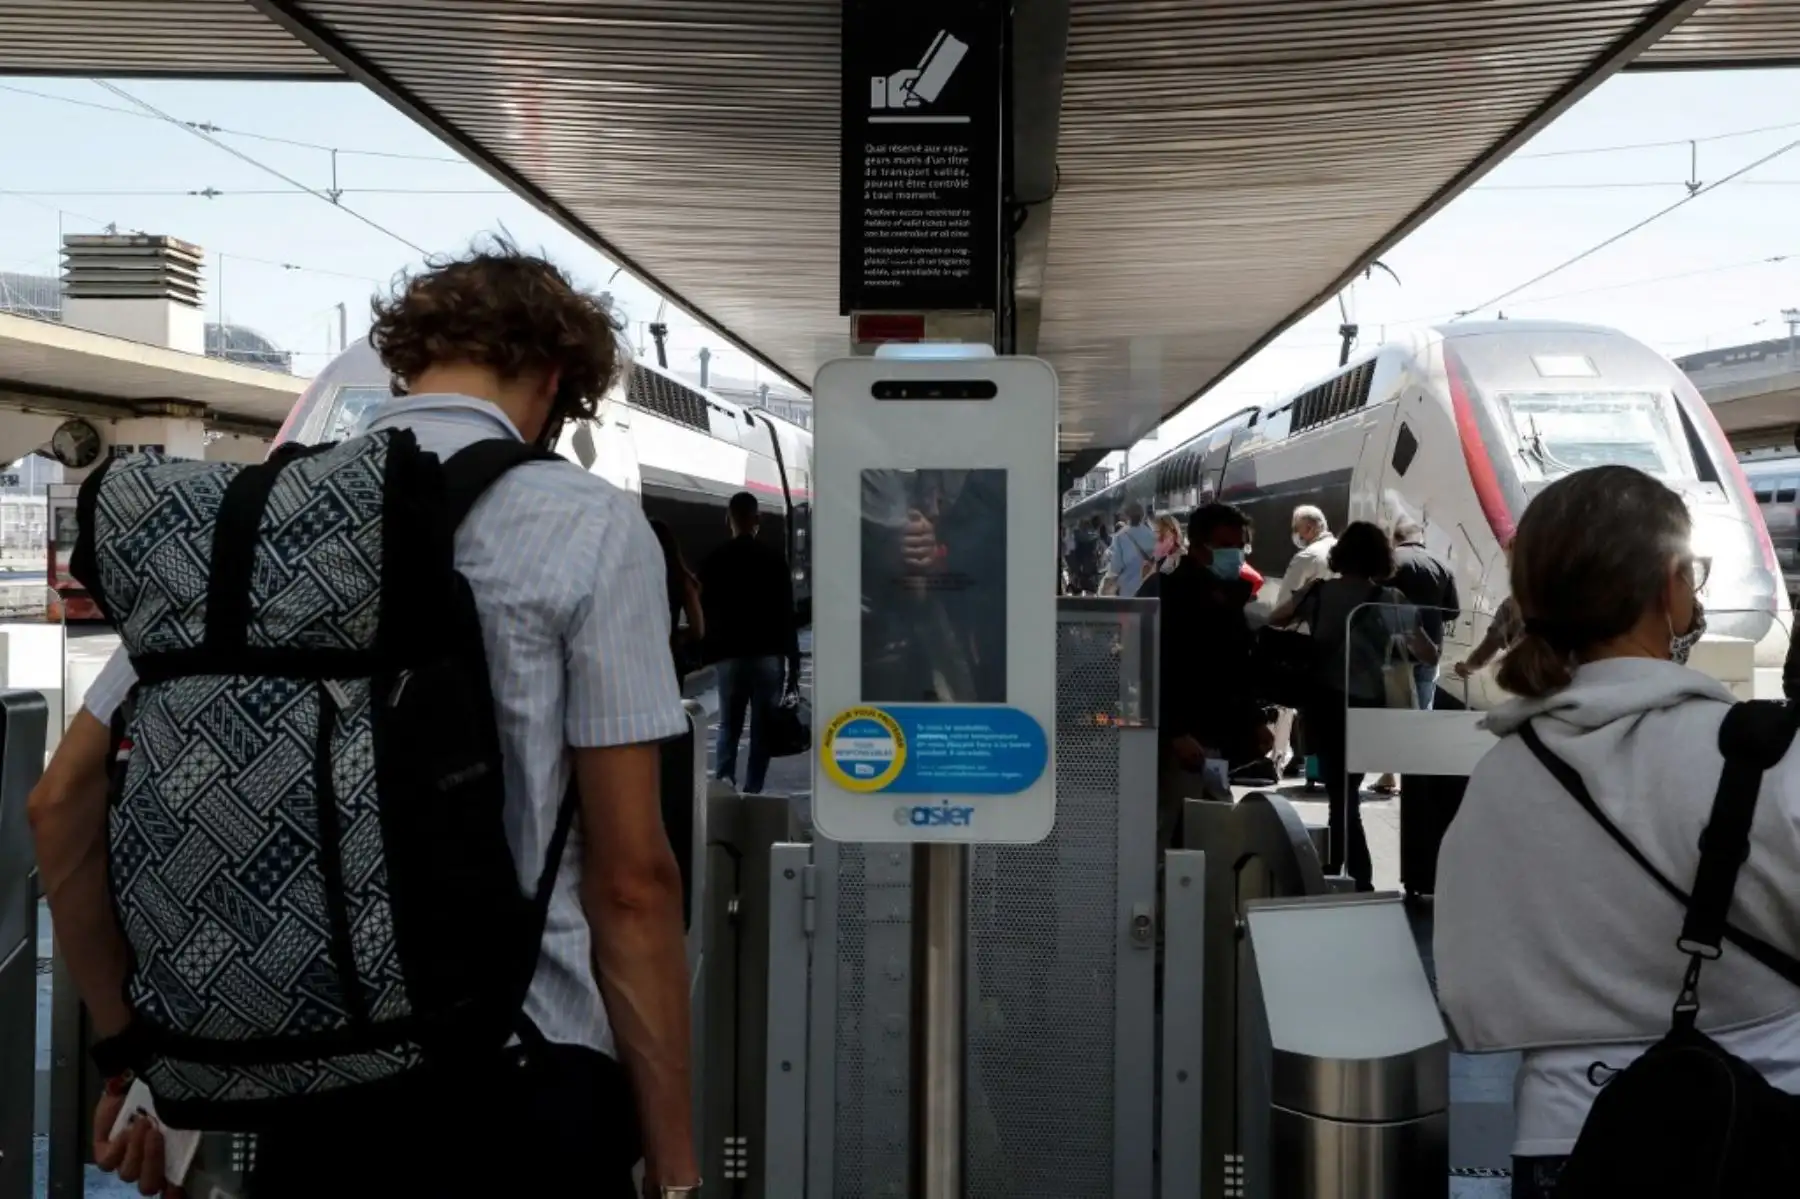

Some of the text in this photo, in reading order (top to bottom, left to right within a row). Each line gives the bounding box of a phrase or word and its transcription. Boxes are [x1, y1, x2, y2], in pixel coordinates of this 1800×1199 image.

[864, 143, 886, 153] Quai
[888, 143, 922, 153] réservé
[923, 145, 940, 153] aux
[893, 156, 922, 165] munis
[924, 155, 946, 165] d'un
[947, 155, 969, 165] titre
[864, 167, 877, 176] de
[880, 167, 930, 179] transport
[864, 178, 969, 189] pouvant être contrôlé
[872, 191, 894, 199] tout
[893, 799, 975, 827] easier
